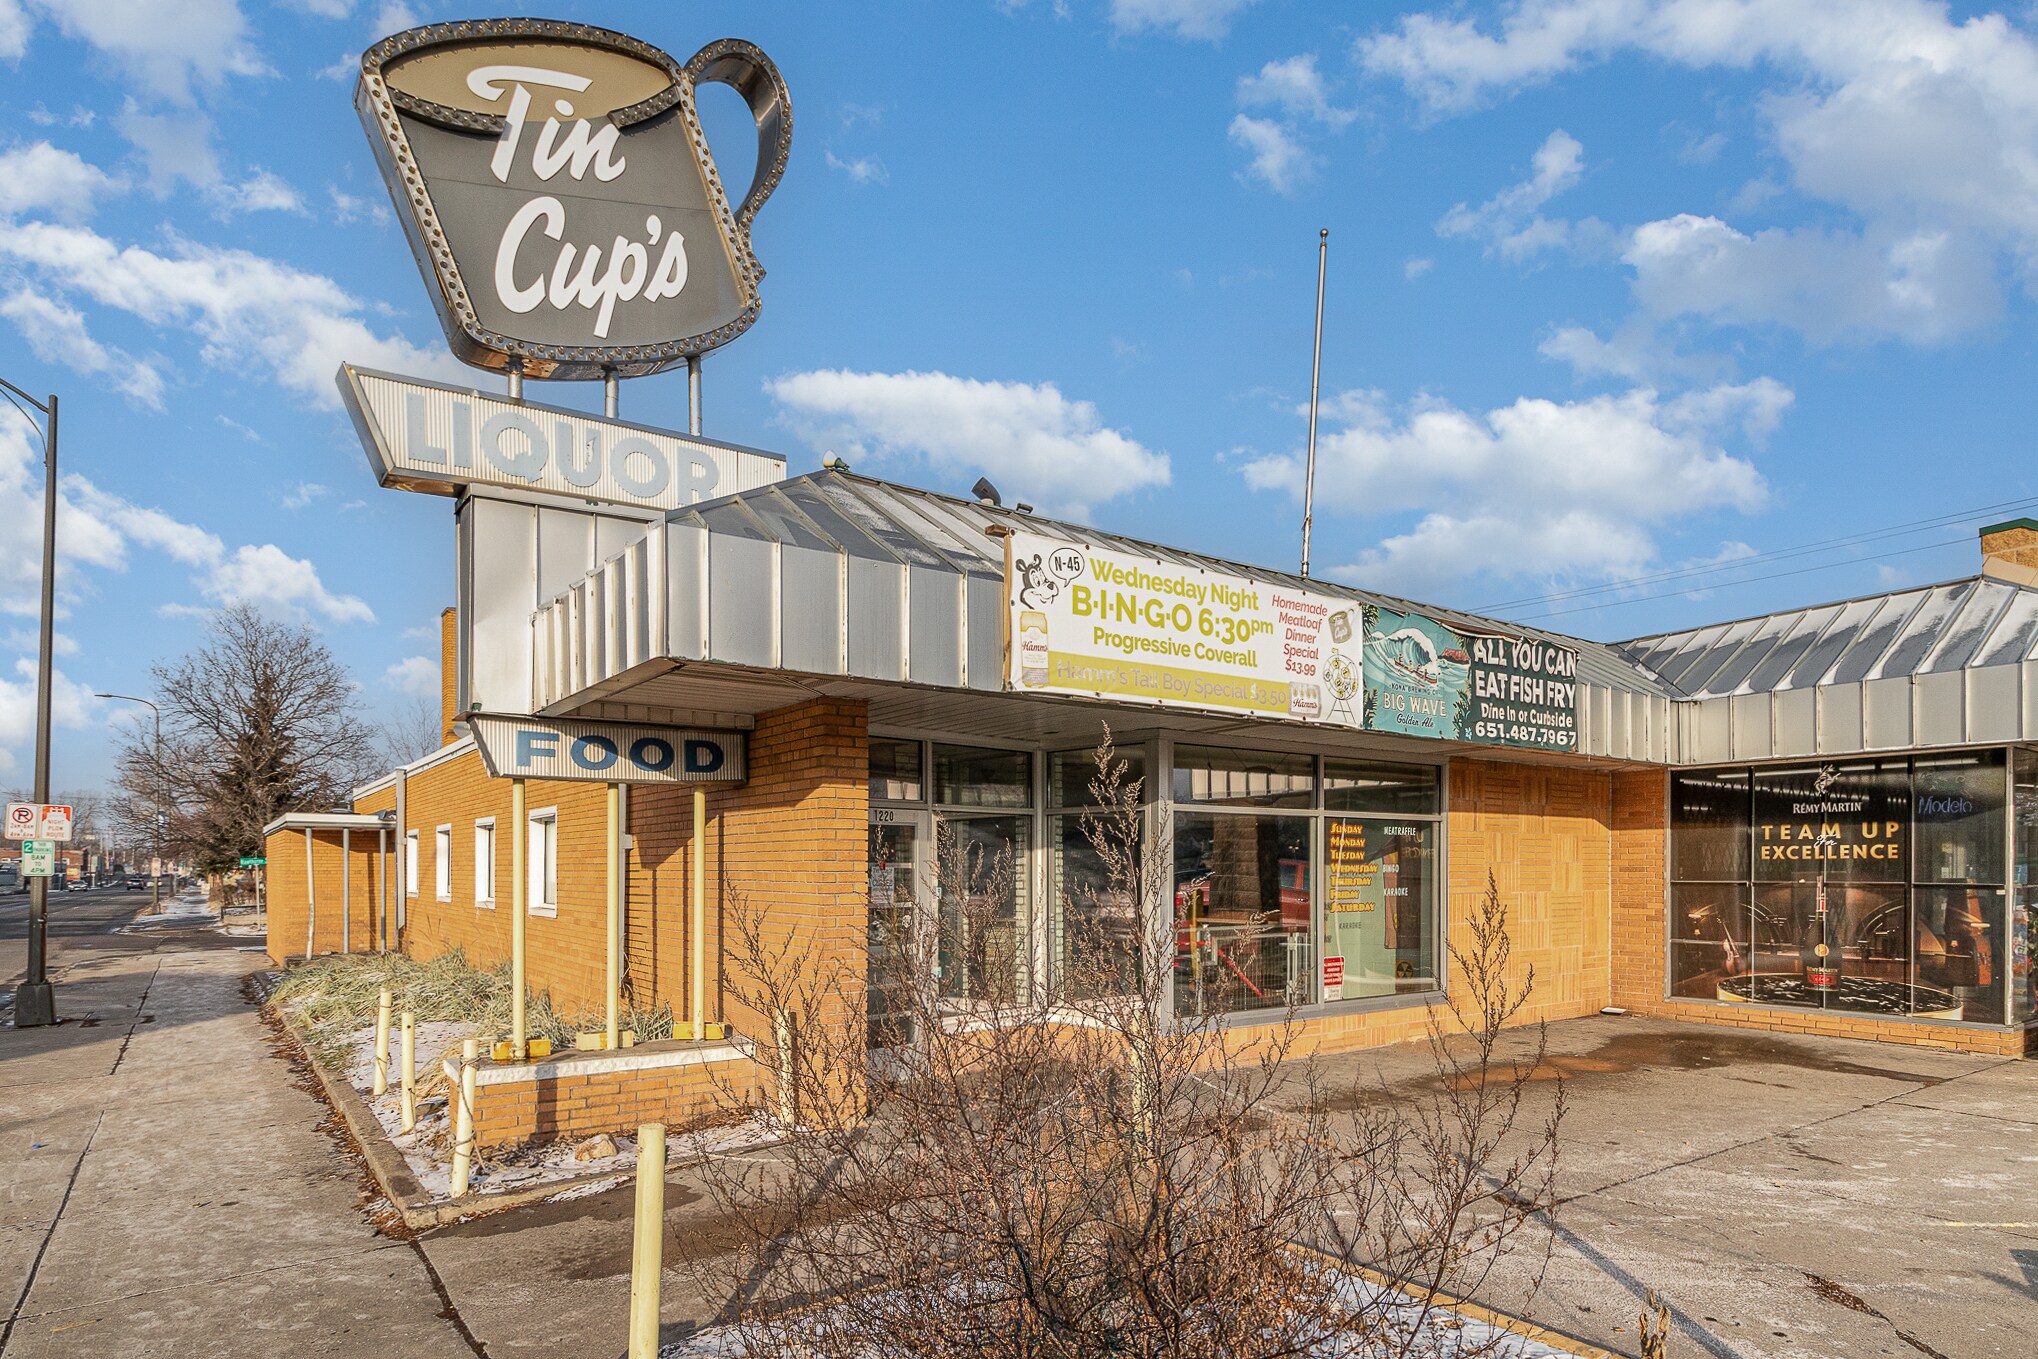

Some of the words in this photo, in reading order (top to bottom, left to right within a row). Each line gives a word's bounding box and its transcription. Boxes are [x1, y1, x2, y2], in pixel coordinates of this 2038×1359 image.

[467, 65, 626, 182] Tin
[494, 197, 688, 338] Cup's
[407, 393, 720, 507] LIQUOR
[1054, 556, 1081, 572] N-45
[1090, 558, 1207, 605] Wednesday
[1211, 583, 1259, 612] Night
[1272, 594, 1328, 617] Homemade
[1279, 611, 1322, 633] Meatloaf
[1093, 626, 1190, 659] Progressive
[1194, 642, 1258, 667] Coverall
[1285, 628, 1316, 644] Dinner
[1283, 643, 1319, 661] Special
[1473, 638, 1507, 666] ALL
[1512, 640, 1542, 672] YOU
[1545, 648, 1576, 677] CAN
[1285, 659, 1316, 677] $13.99
[1057, 660, 1128, 686] Hamm's
[1131, 669, 1159, 689] Tall
[1163, 674, 1191, 697] Boy
[1194, 678, 1247, 699] Special
[1250, 684, 1287, 706] $3.50
[1475, 670, 1508, 699] EAT
[1510, 675, 1544, 705] FISH
[1547, 681, 1576, 708] FRY
[1383, 692, 1405, 712] BIG
[1410, 696, 1447, 717] WAVE
[1481, 702, 1505, 720] Dine
[1506, 706, 1516, 721] In
[1518, 711, 1528, 723] or
[1530, 709, 1573, 728] Curbside
[1396, 713, 1419, 727] Golden
[1422, 717, 1434, 728] Ale
[1475, 721, 1576, 746] 651.487.7967
[516, 730, 724, 773] FOOD
[874, 810, 894, 821] 1220
[1793, 802, 1820, 814] RÉMY
[1822, 802, 1862, 813] MARTIN
[1918, 795, 1973, 814] Modelo
[1761, 823, 1841, 840] TEAM
[1861, 821, 1900, 839] UP
[1761, 844, 1899, 860] EXCELLENCE
[1384, 887, 1408, 896] KARAOKE
